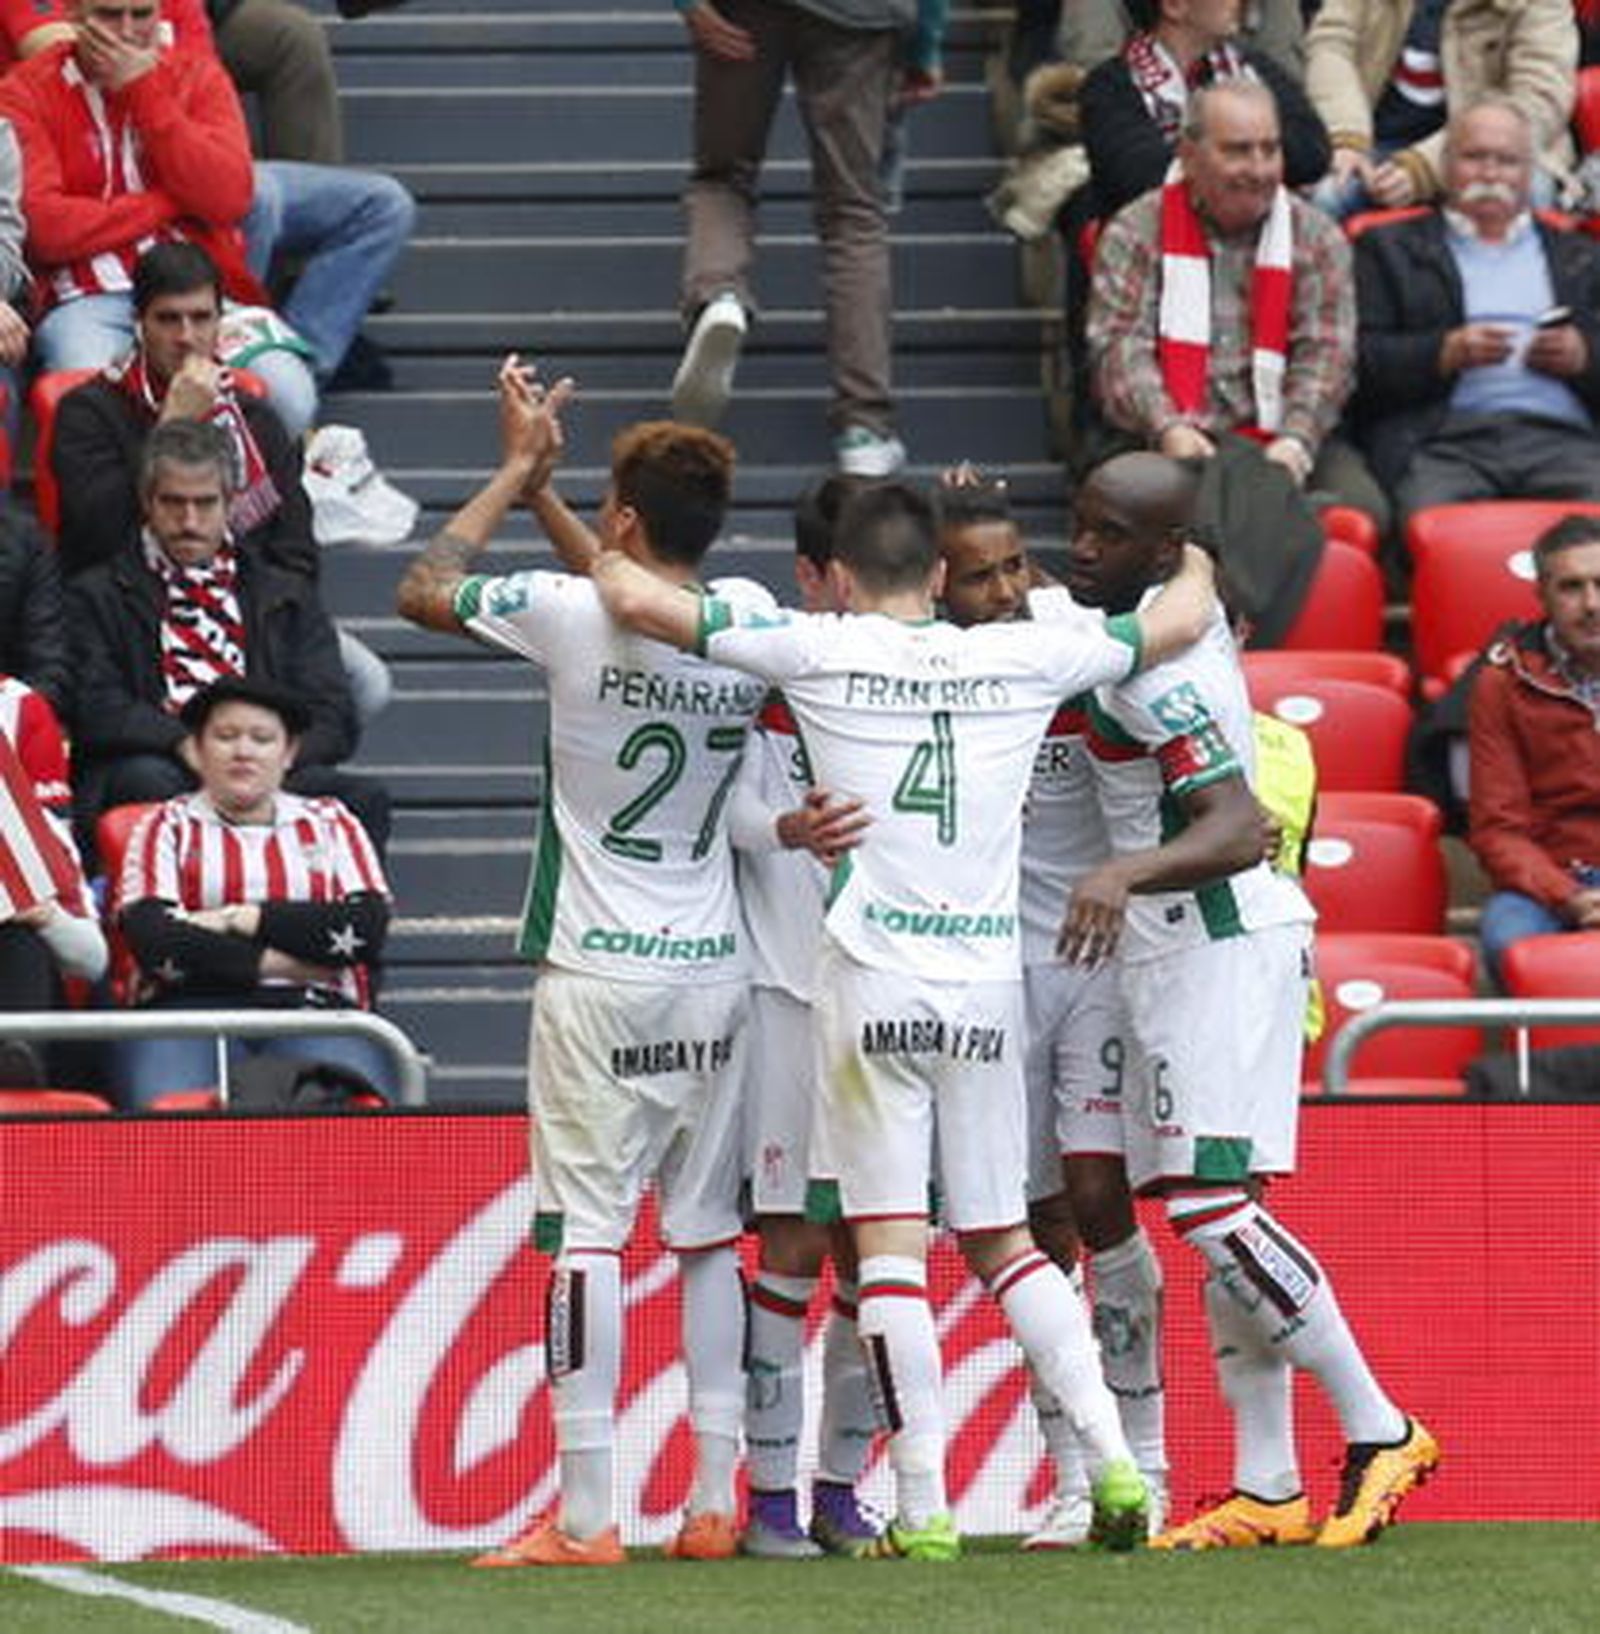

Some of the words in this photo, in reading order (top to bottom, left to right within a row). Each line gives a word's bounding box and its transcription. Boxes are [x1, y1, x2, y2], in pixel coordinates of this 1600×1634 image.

[601, 721, 748, 863] 27
[892, 710, 956, 847] 4
[1100, 1035, 1125, 1096] 9
[1153, 1055, 1174, 1122] 6
